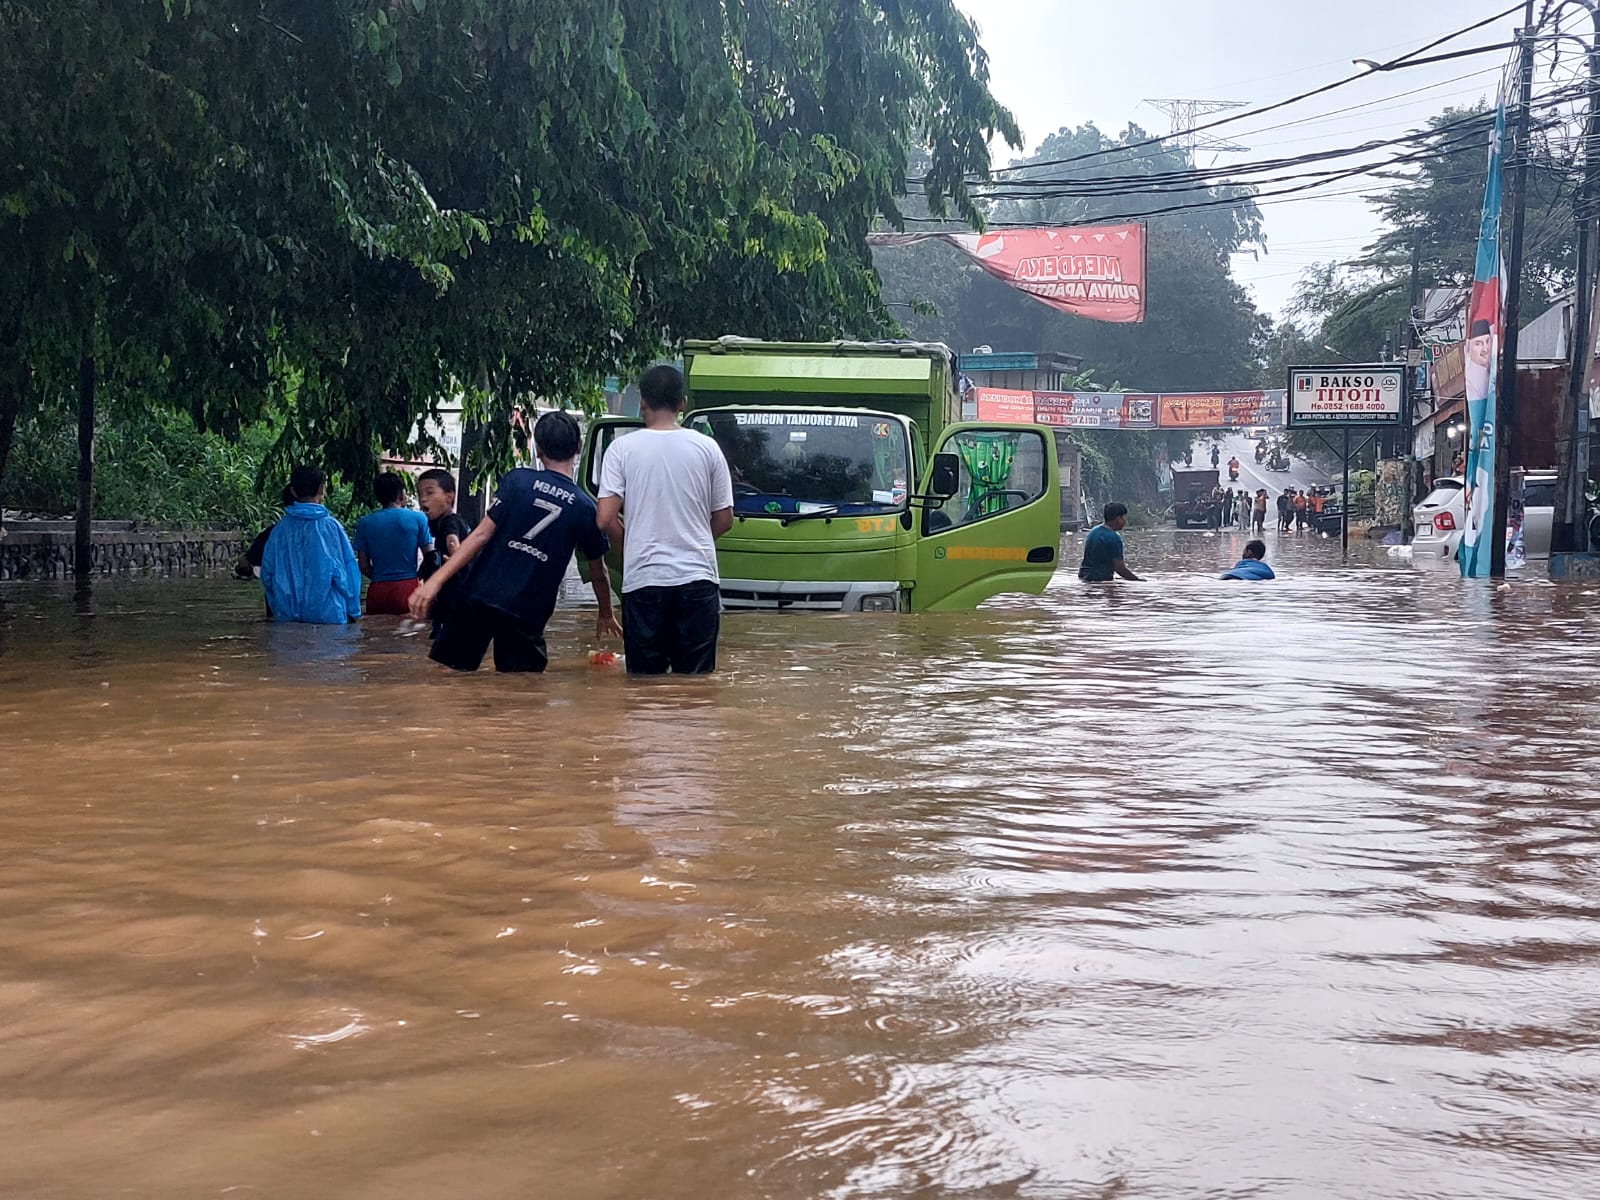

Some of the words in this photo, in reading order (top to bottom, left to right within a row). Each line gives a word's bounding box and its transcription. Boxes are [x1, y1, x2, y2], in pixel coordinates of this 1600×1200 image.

[1320, 376, 1374, 388] BAKSO
[1316, 388, 1381, 402] TITOTI
[735, 413, 784, 425] BANGUN
[785, 413, 833, 427] TANJONG
[833, 415, 858, 428] JAYA
[522, 498, 563, 541] 7
[856, 518, 897, 533] BTJ
